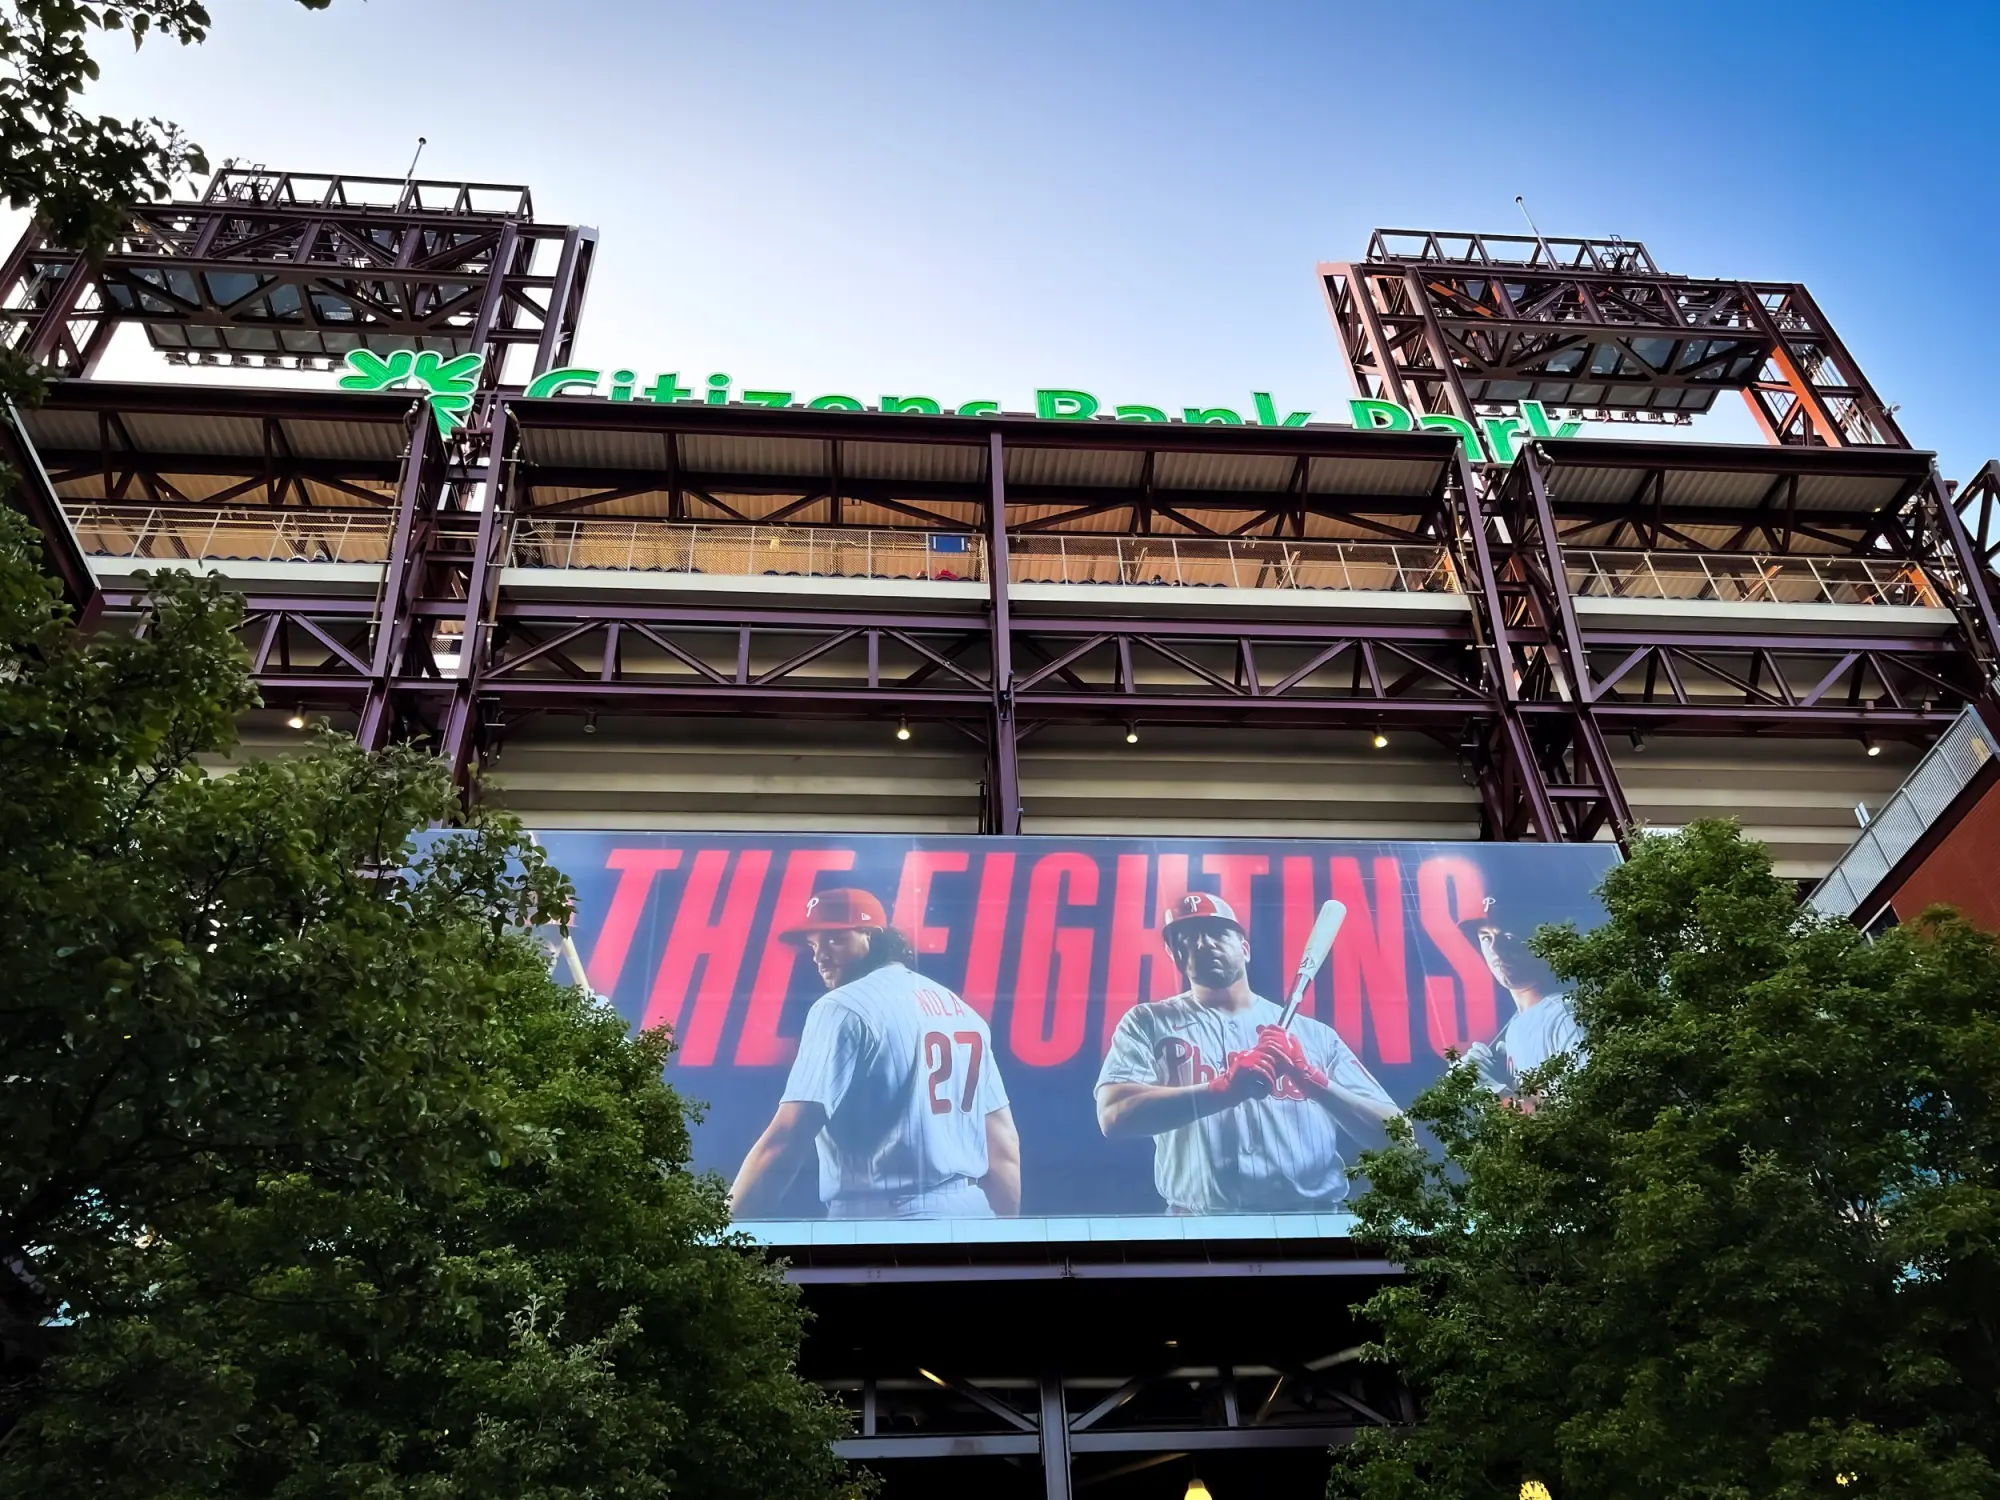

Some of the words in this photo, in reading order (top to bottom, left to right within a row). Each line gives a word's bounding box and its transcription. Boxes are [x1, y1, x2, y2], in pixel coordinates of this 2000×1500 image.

[585, 848, 856, 1067] THE
[911, 988, 966, 1017] NOLA
[924, 1030, 984, 1116] 27
